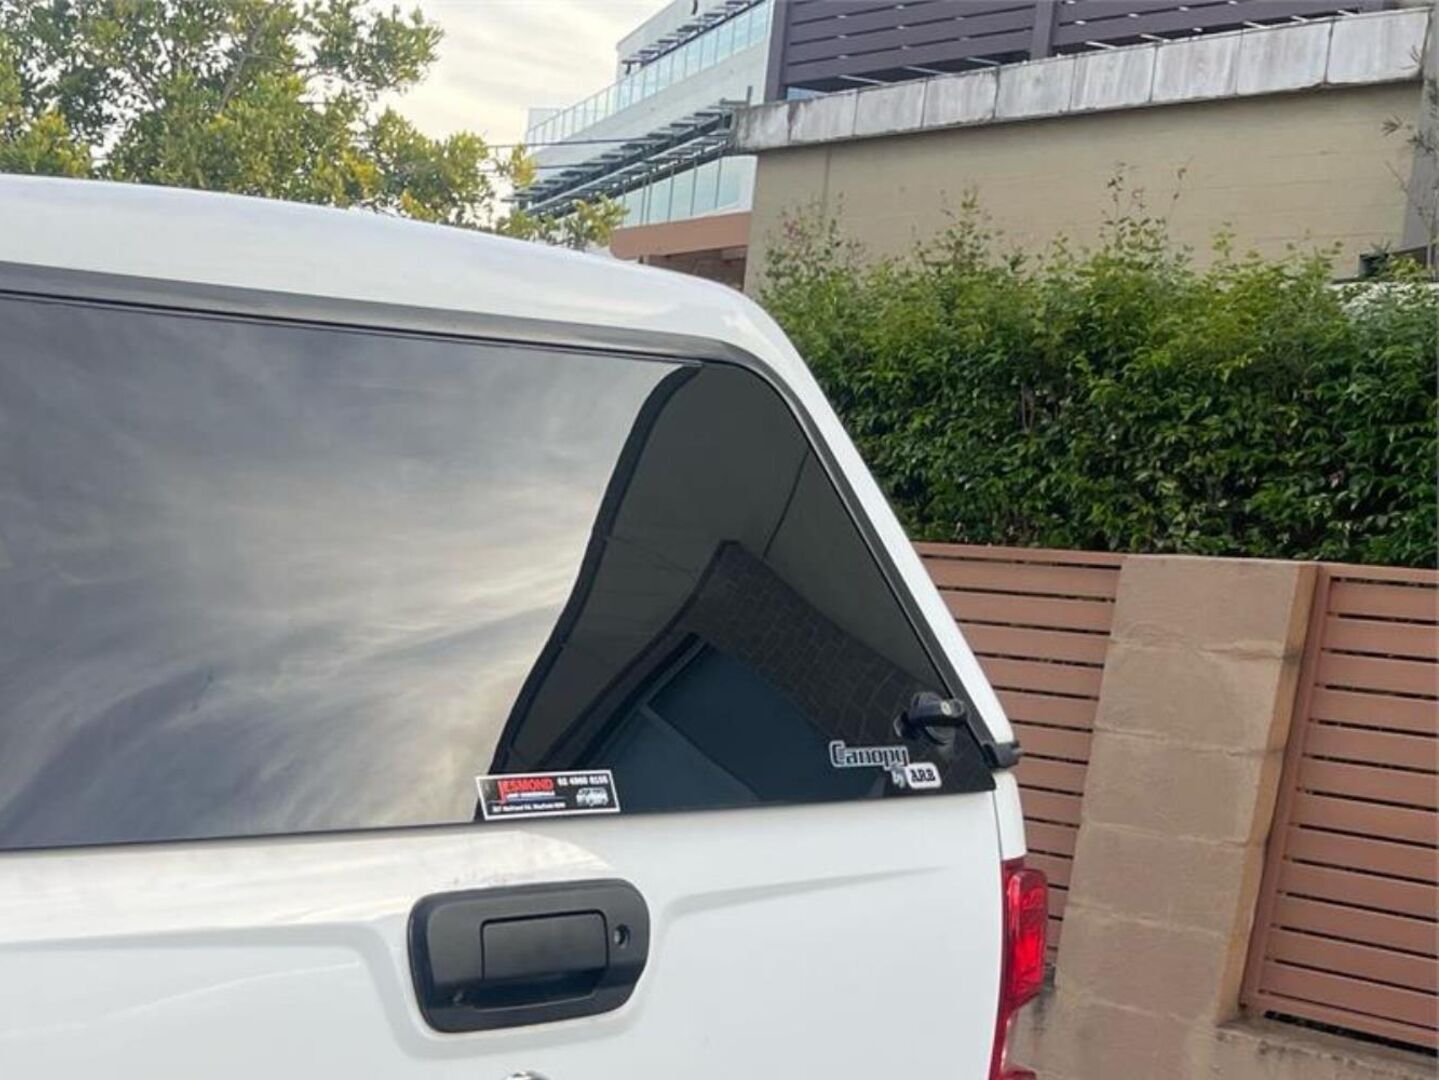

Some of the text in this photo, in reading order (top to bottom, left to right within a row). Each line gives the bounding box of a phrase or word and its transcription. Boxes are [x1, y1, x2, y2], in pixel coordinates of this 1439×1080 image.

[829, 740, 909, 769] Canopy
[911, 768, 937, 783] ARB
[498, 777, 554, 804] JESMOND
